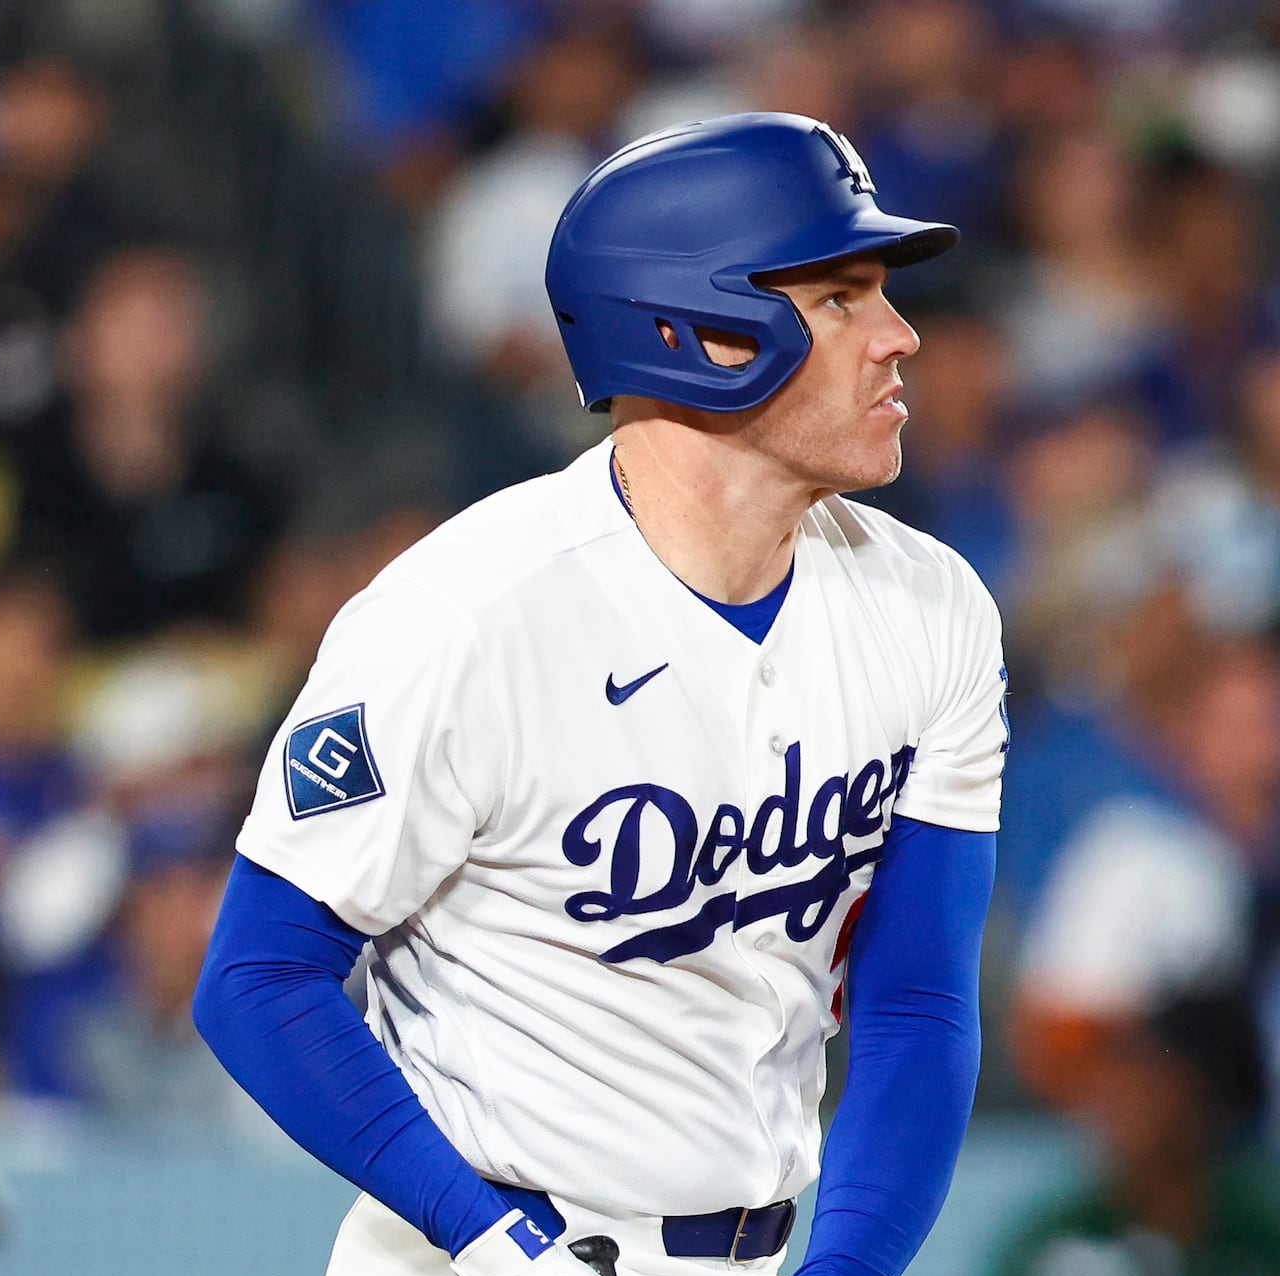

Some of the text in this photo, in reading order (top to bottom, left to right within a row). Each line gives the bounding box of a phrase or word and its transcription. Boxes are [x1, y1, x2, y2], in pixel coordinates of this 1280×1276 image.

[308, 727, 358, 779] G
[290, 758, 348, 801] GUGGENHEIM
[562, 740, 918, 943] Dodger
